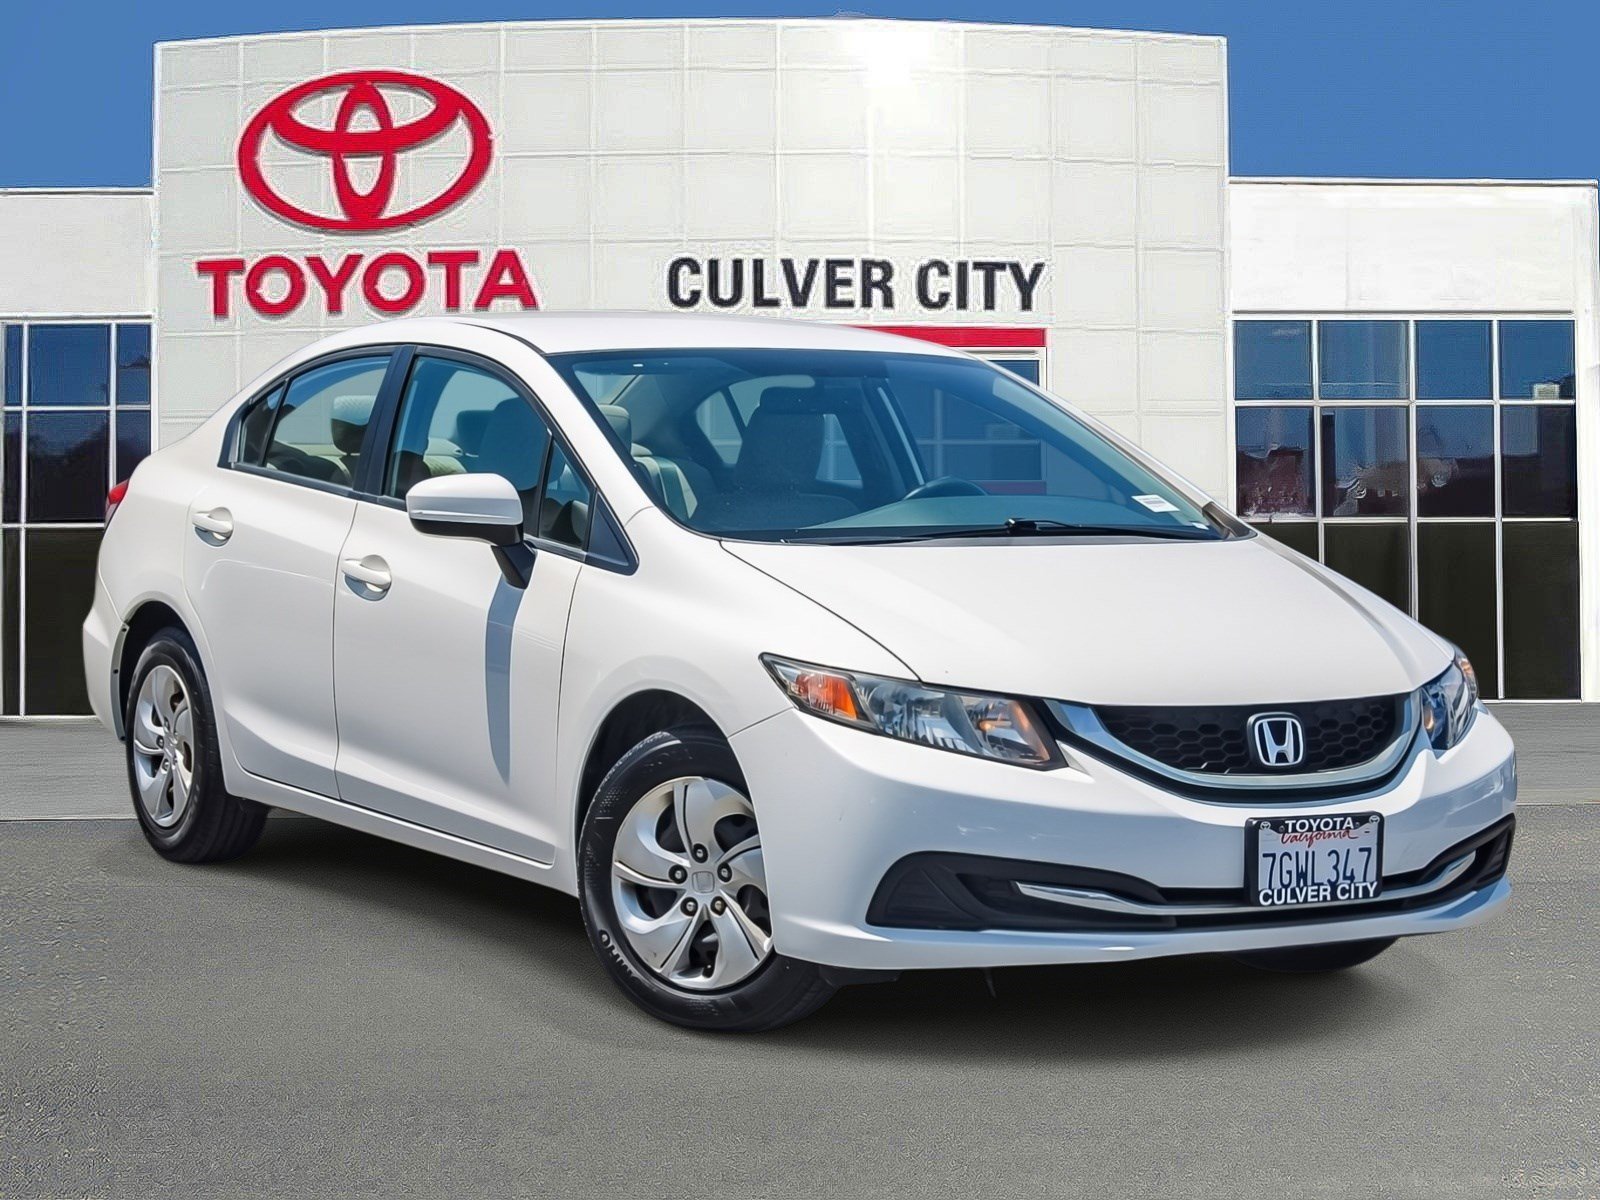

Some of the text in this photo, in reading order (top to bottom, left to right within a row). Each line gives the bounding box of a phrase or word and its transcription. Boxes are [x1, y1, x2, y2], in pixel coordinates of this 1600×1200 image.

[197, 249, 539, 318] TOYOTA
[667, 257, 1046, 312] CULVER CITY
[1285, 817, 1354, 833] TOYOTA
[1259, 881, 1378, 906] CULVER CITY
